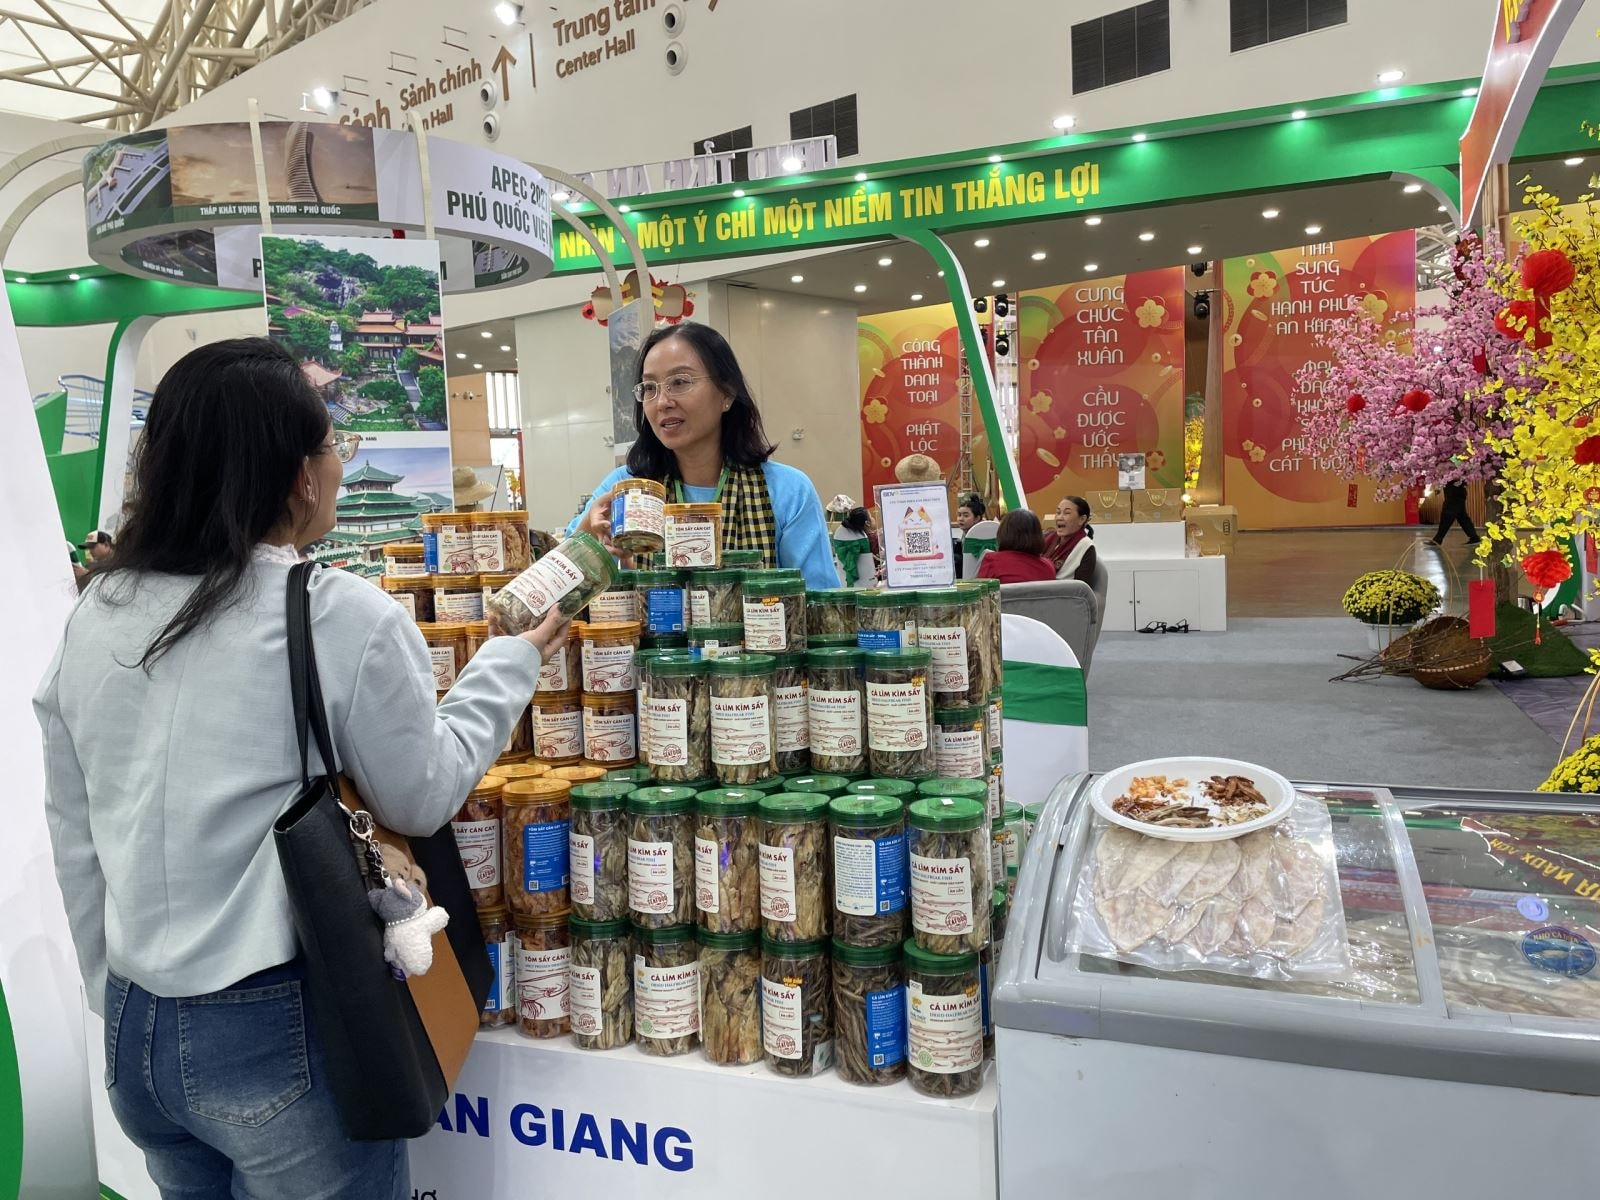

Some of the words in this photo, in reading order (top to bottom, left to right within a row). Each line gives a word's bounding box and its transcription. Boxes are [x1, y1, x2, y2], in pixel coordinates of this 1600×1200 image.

[553, 7, 610, 46] Trung
[556, 47, 603, 78] Center
[605, 28, 635, 59] Hall
[400, 77, 436, 111] Sảnh
[439, 58, 482, 95] chính
[430, 103, 454, 128] Hall
[491, 165, 528, 200] APEC
[447, 190, 488, 222] PHÚ
[492, 199, 531, 235] QUỐC
[637, 214, 686, 254] MỘT
[692, 209, 708, 243] Ý
[715, 202, 756, 240] CHÍ
[764, 197, 817, 239] MỘT
[824, 185, 893, 229] NIỀM
[900, 185, 944, 218] TIN
[952, 164, 1046, 213] THẮNG
[1054, 162, 1100, 204] LỢI
[1295, 259, 1340, 276] SUNG
[1300, 277, 1336, 294] TÚC
[1075, 286, 1125, 304] CUNG
[1271, 300, 1312, 317] HẠNH
[1319, 294, 1363, 313] PHÚ
[1076, 304, 1124, 324] CHÚC
[1082, 325, 1118, 344] TÂN
[1276, 321, 1299, 335] AN
[902, 338, 941, 355] CÔNG
[901, 355, 943, 370] THÀNH
[1077, 346, 1124, 366] XUÂN
[904, 373, 940, 387] DANH
[907, 391, 938, 405] TOẠI
[1083, 385, 1120, 407] CẦU
[906, 420, 941, 436] PHÁT
[1077, 410, 1126, 430] ĐƯỢC
[910, 437, 938, 454] LỘC
[1083, 430, 1120, 448] ƯỚC
[1269, 455, 1303, 472] CÁT
[947, 631, 961, 640] SẤY
[784, 692, 798, 700] KÌM
[816, 695, 827, 703] LÌM
[827, 696, 842, 704] KÌM
[843, 695, 857, 704] SẤY
[878, 688, 891, 697] LÌM
[891, 688, 906, 697] KÌM
[908, 687, 921, 696] SẤY
[655, 703, 666, 712] KÌM
[667, 702, 681, 712] SẤY
[715, 703, 722, 711] CÁ
[722, 703, 734, 712] LÌM
[735, 702, 750, 711] KÌM
[752, 700, 765, 709] SẤY
[456, 826, 468, 834] SẤY
[577, 840, 589, 849] SẤY
[637, 847, 652, 856] KÌM
[653, 846, 668, 856] SẤY
[701, 844, 713, 855] SẤY
[773, 850, 788, 862] SẤY
[918, 864, 929, 872] LÌM
[930, 866, 947, 874] KÌM
[949, 863, 965, 873] SẤY
[538, 954, 550, 963] SẤY
[551, 953, 566, 961] CÁN
[581, 971, 595, 980] SẤY
[650, 973, 660, 982] CÁ
[662, 973, 676, 982] LÌM
[677, 970, 691, 980] KÌM
[767, 988, 779, 998] KÌM
[780, 988, 796, 1000] SẤY
[929, 1002, 941, 1011] CÁ
[942, 1002, 957, 1011] LÌM
[958, 998, 973, 1009] KÌM
[510, 1103, 694, 1172] GIANG
